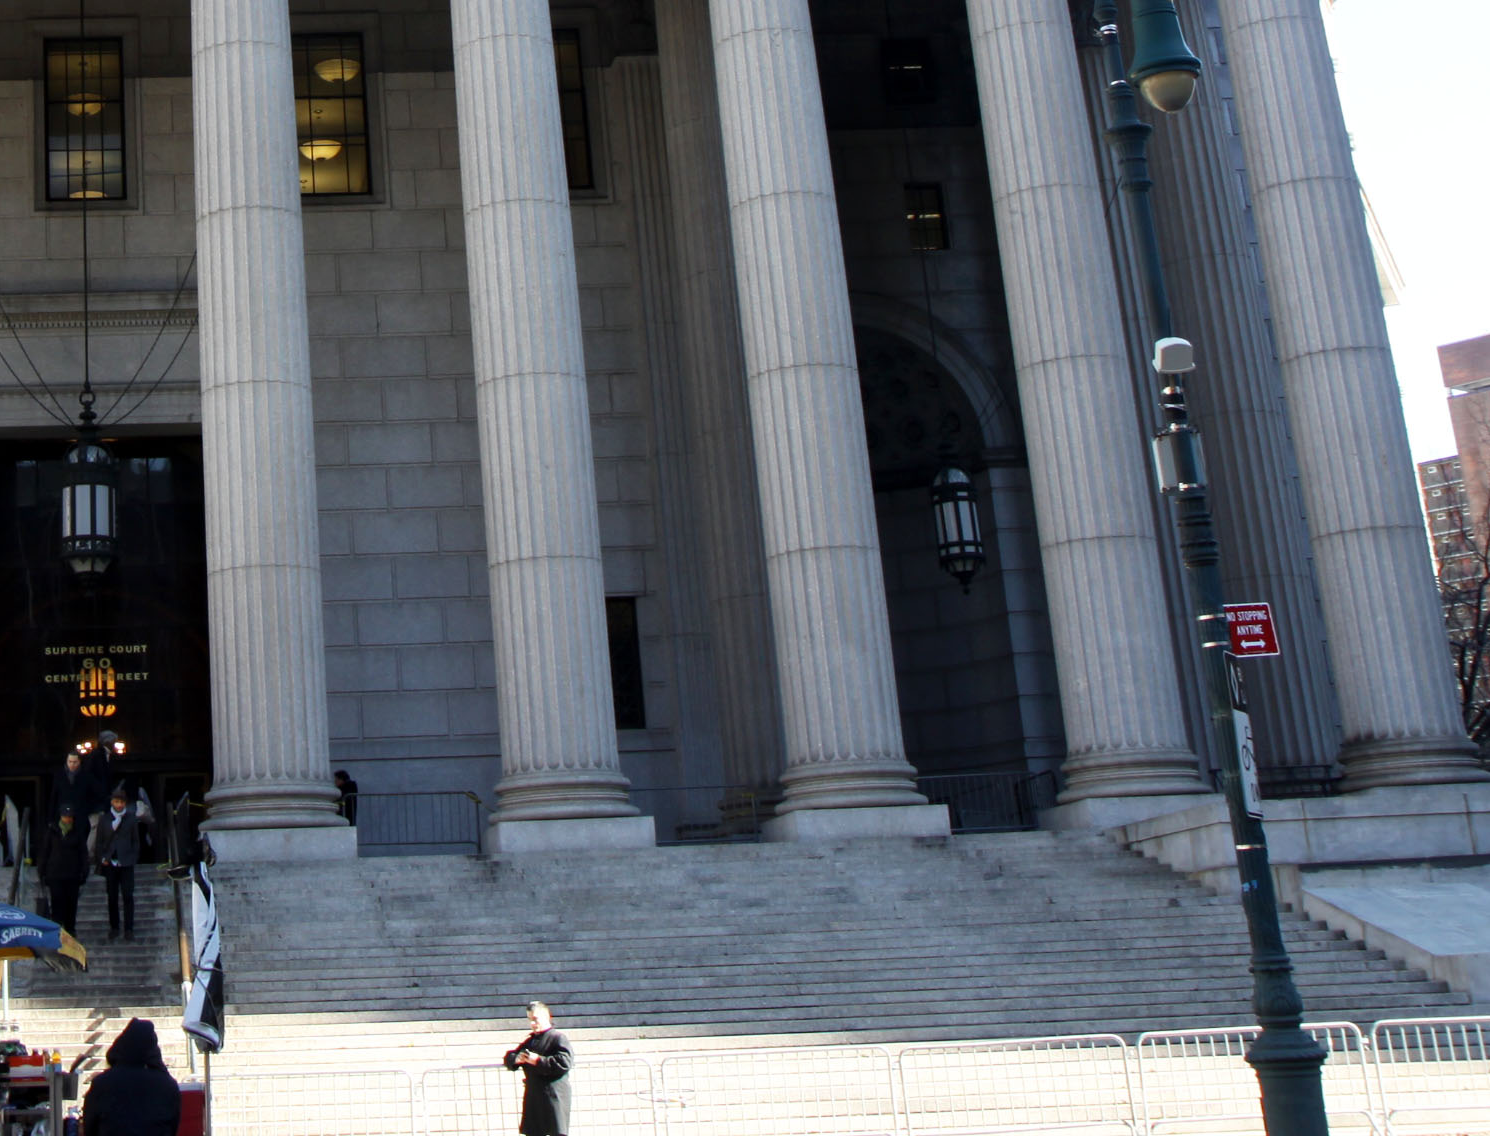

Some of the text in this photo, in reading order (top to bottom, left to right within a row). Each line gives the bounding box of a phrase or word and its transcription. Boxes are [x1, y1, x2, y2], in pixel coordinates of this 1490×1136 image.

[1225, 610, 1268, 621] NO STOPPING
[1237, 624, 1264, 636] ANYTIME
[45, 644, 148, 655] SUPREME COURT
[82, 657, 112, 669] 60
[0, 926, 43, 944] SABRETT
